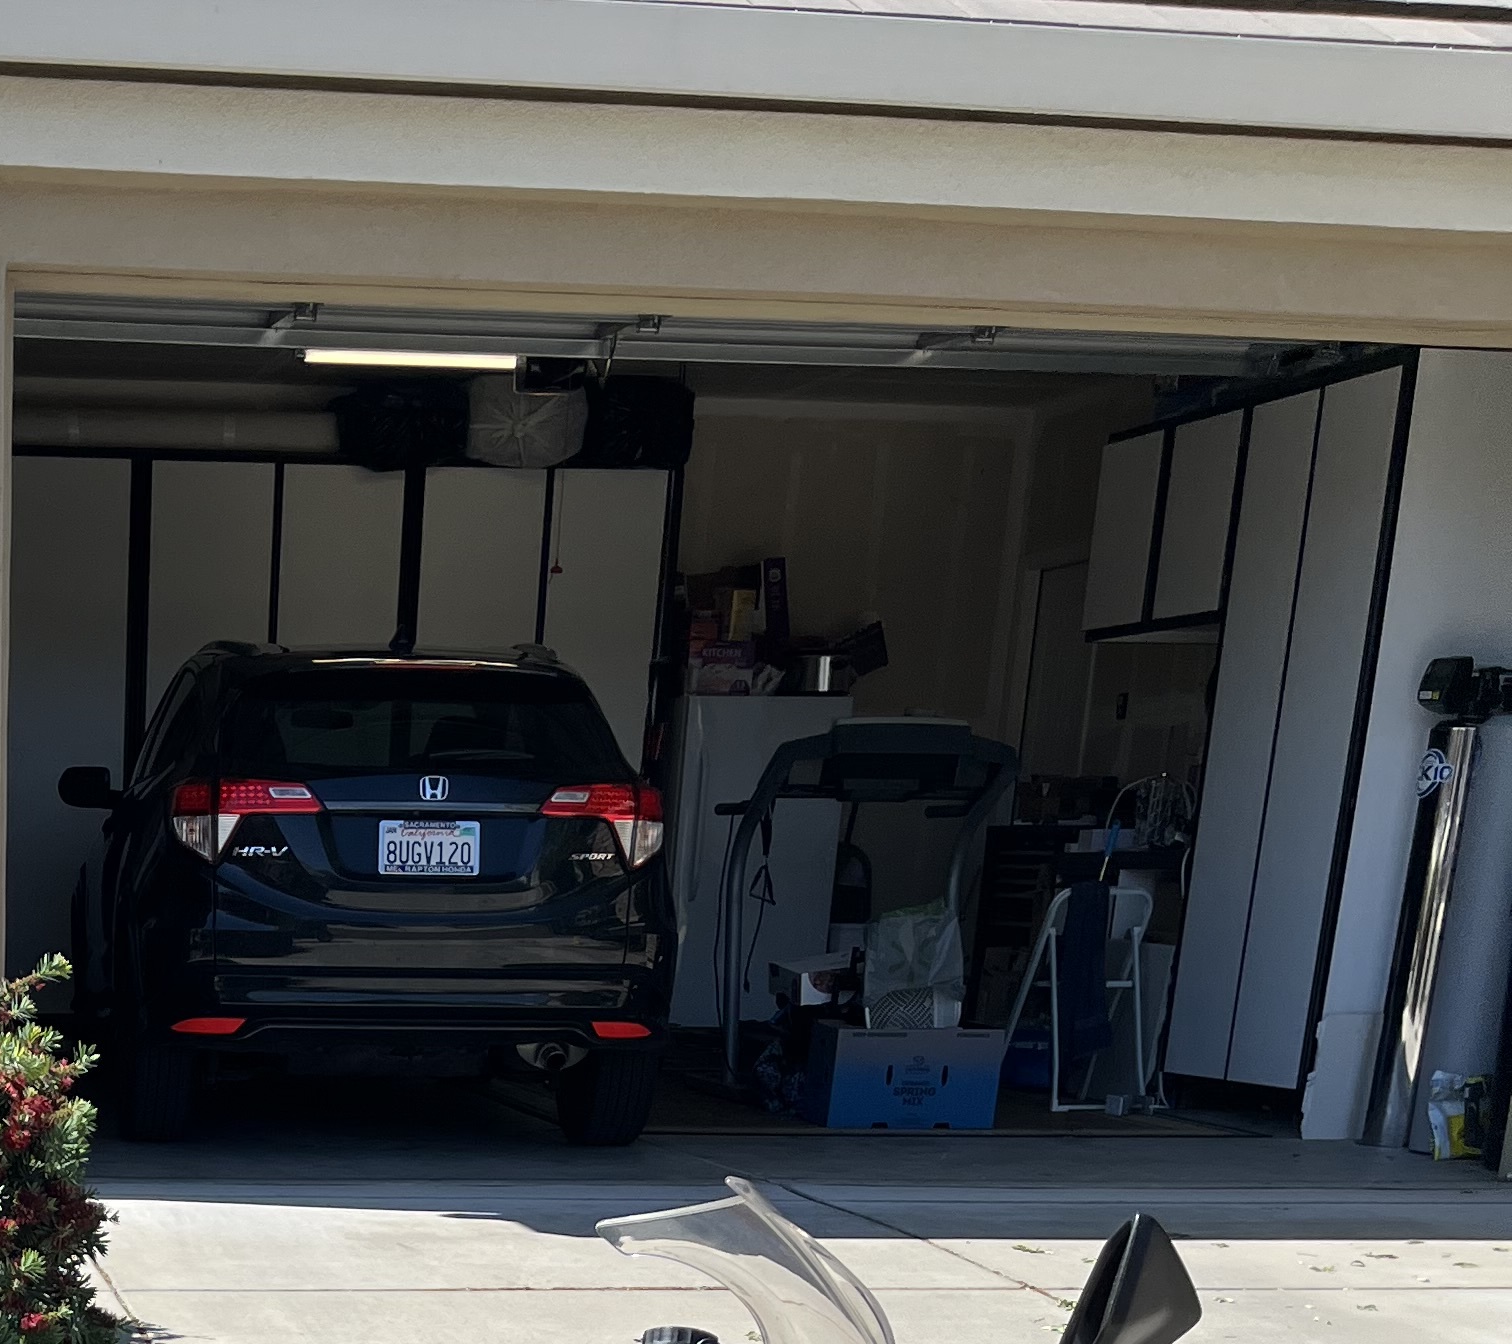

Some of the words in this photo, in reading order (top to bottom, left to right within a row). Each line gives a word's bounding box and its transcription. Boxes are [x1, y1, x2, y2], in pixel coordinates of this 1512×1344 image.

[405, 821, 456, 829] SACRAMENTO
[232, 846, 289, 857] HR-V
[387, 840, 471, 865] 8UGV120
[570, 852, 616, 861] SPORT
[902, 1096, 925, 1106] MIX
